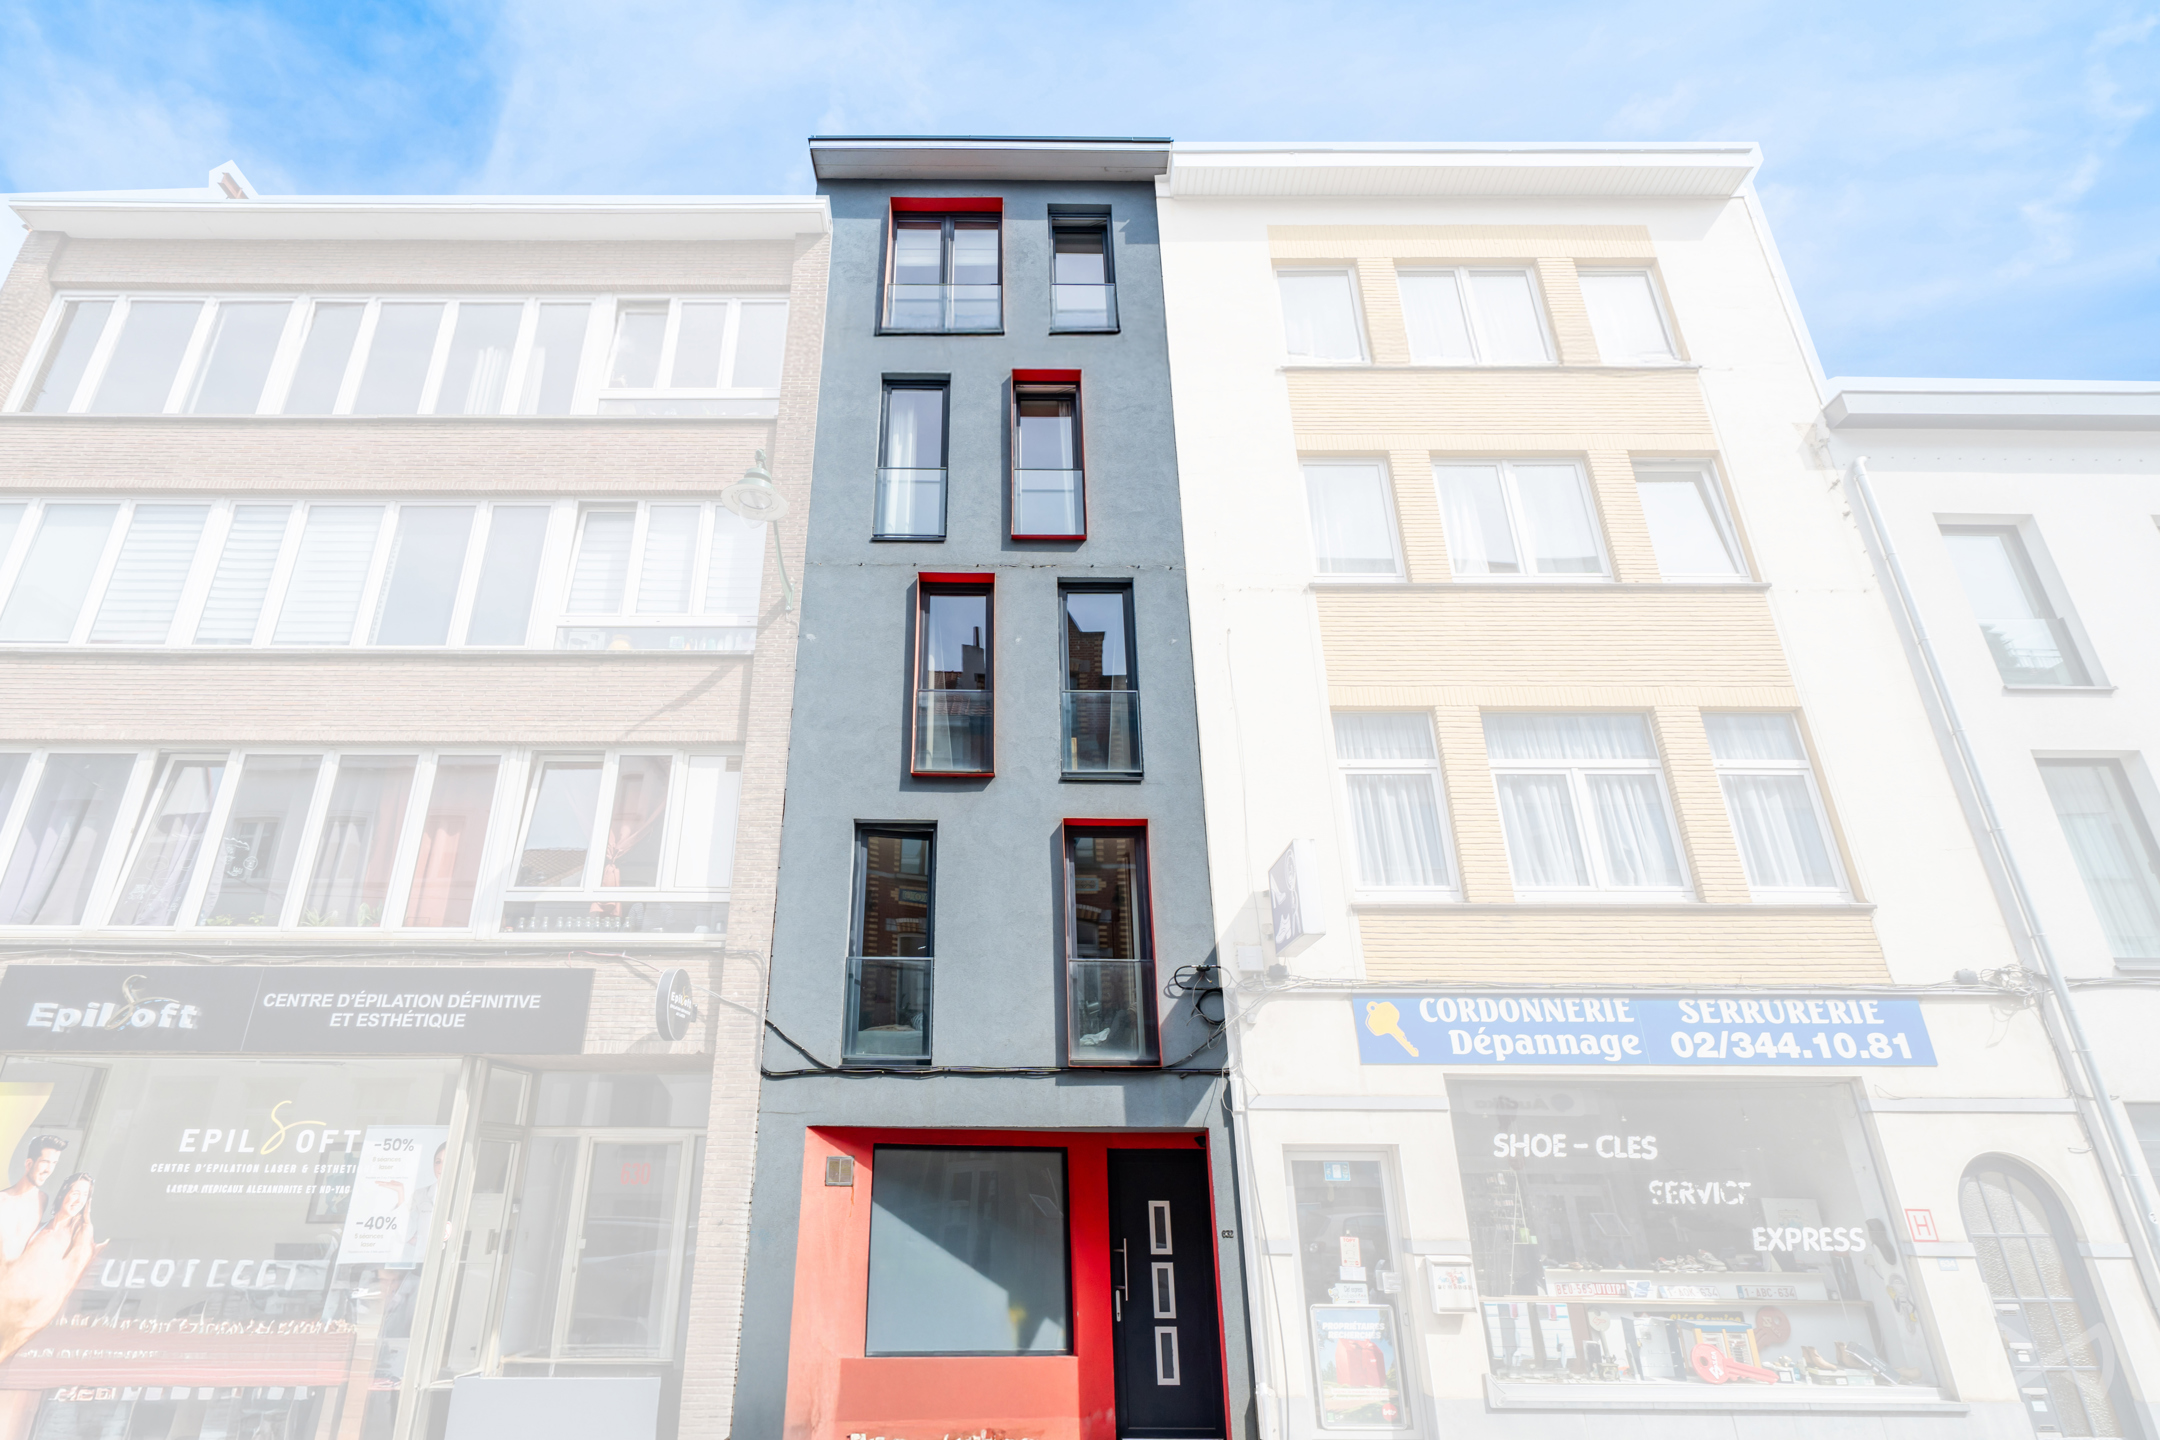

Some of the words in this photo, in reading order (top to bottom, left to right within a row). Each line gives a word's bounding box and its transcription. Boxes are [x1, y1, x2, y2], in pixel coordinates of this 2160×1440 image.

[263, 993, 334, 1008] CENTRE
[337, 990, 444, 1009] D'ÉPILATION
[447, 990, 542, 1009] DÉFINITIVE
[329, 1012, 354, 1028] ET
[356, 1009, 467, 1028] ESTHÉTIQUE
[1419, 997, 1635, 1023] CORDONNERIE
[1678, 998, 1885, 1025] SERRURERIE
[1448, 1027, 1643, 1062] Dépannage
[1671, 1031, 1913, 1060] 02/344.10.81
[374, 1138, 415, 1152] -50%
[1493, 1132, 1567, 1158] SHOE
[1595, 1134, 1659, 1160] CLES
[150, 1163, 191, 1173] CENTRE
[194, 1163, 260, 1174] D'EPILATION
[264, 1163, 297, 1174] LASER
[620, 1162, 651, 1186] 630
[246, 1184, 303, 1194] ALEXANDRITE
[305, 1185, 316, 1194] ET
[355, 1215, 398, 1231] -40%
[1913, 1214, 1932, 1237] H
[1752, 1226, 1867, 1253] EXPRESS
[1322, 1321, 1385, 1331] PROPRIÉTAIRES
